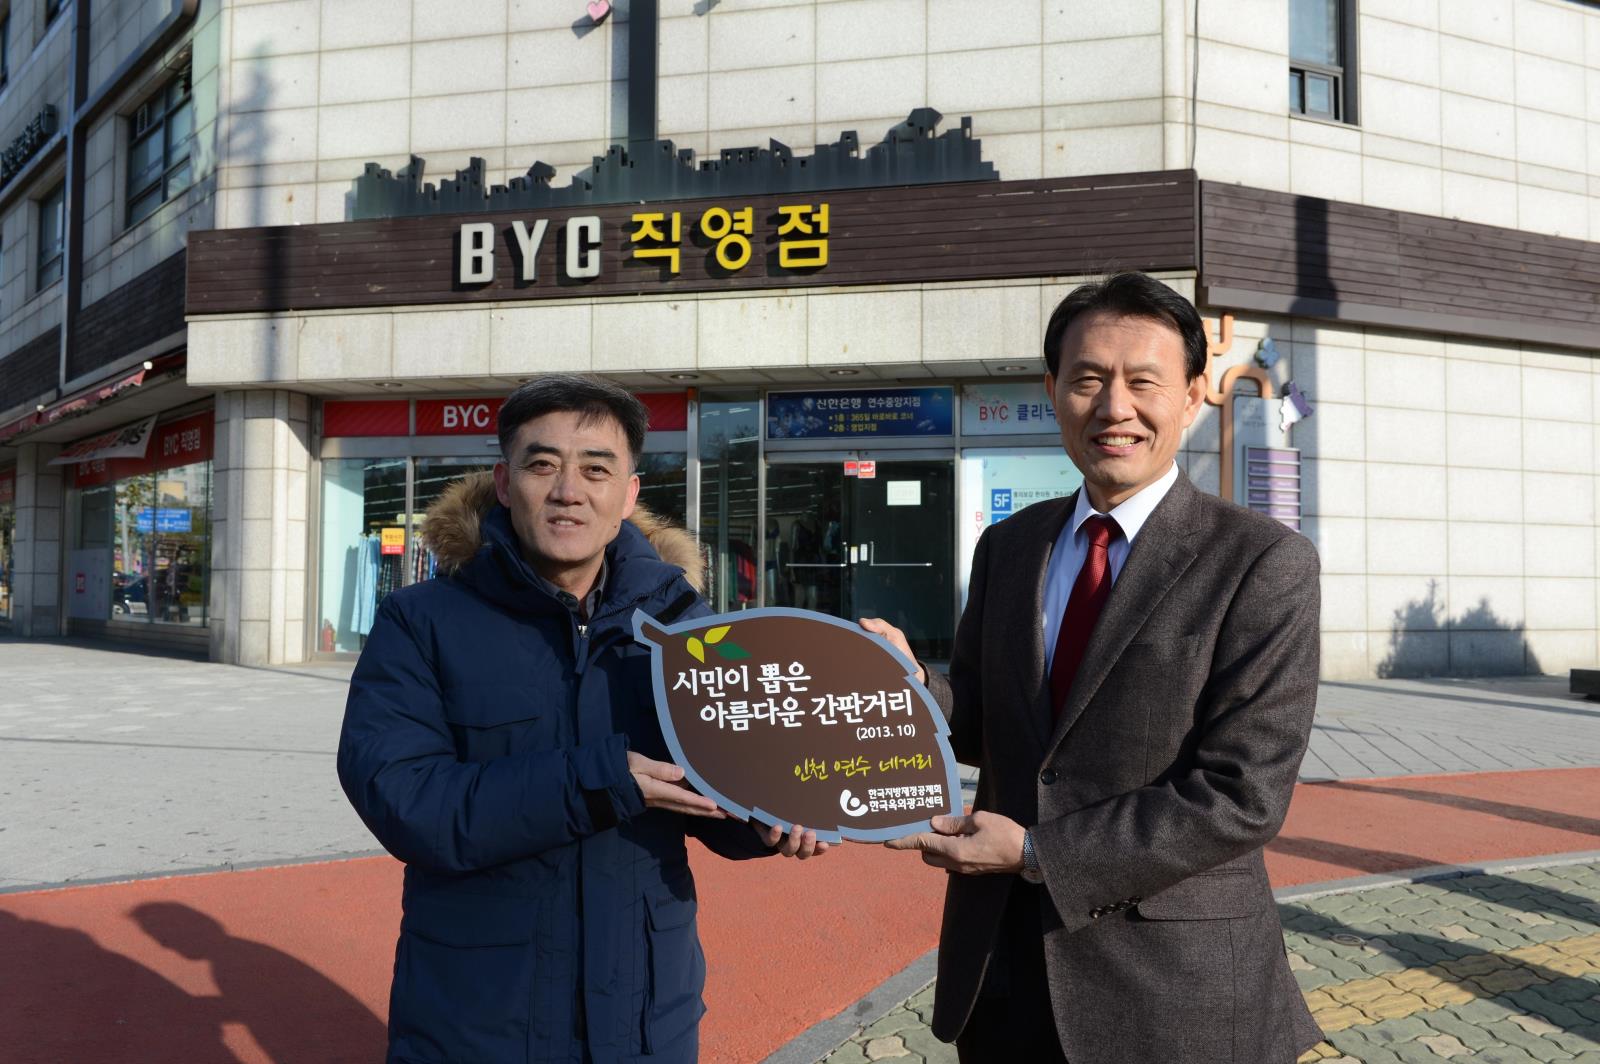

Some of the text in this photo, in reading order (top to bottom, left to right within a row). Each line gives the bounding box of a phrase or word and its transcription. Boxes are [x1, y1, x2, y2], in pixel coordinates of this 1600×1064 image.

[460, 203, 829, 284] BYC 직영점
[816, 395, 921, 410] 신한은행 연수중앙지점
[443, 404, 490, 428] BYC
[979, 405, 1009, 421] BYC
[993, 493, 1010, 508] 5F
[673, 661, 811, 697] 시민이 뽑은
[700, 688, 913, 732] 아름다운 간판거리
[793, 753, 933, 782] 인천 연수 네거리
[867, 784, 943, 799] 한국지방재정공제회
[869, 796, 944, 812] 한국옥외광고센터
